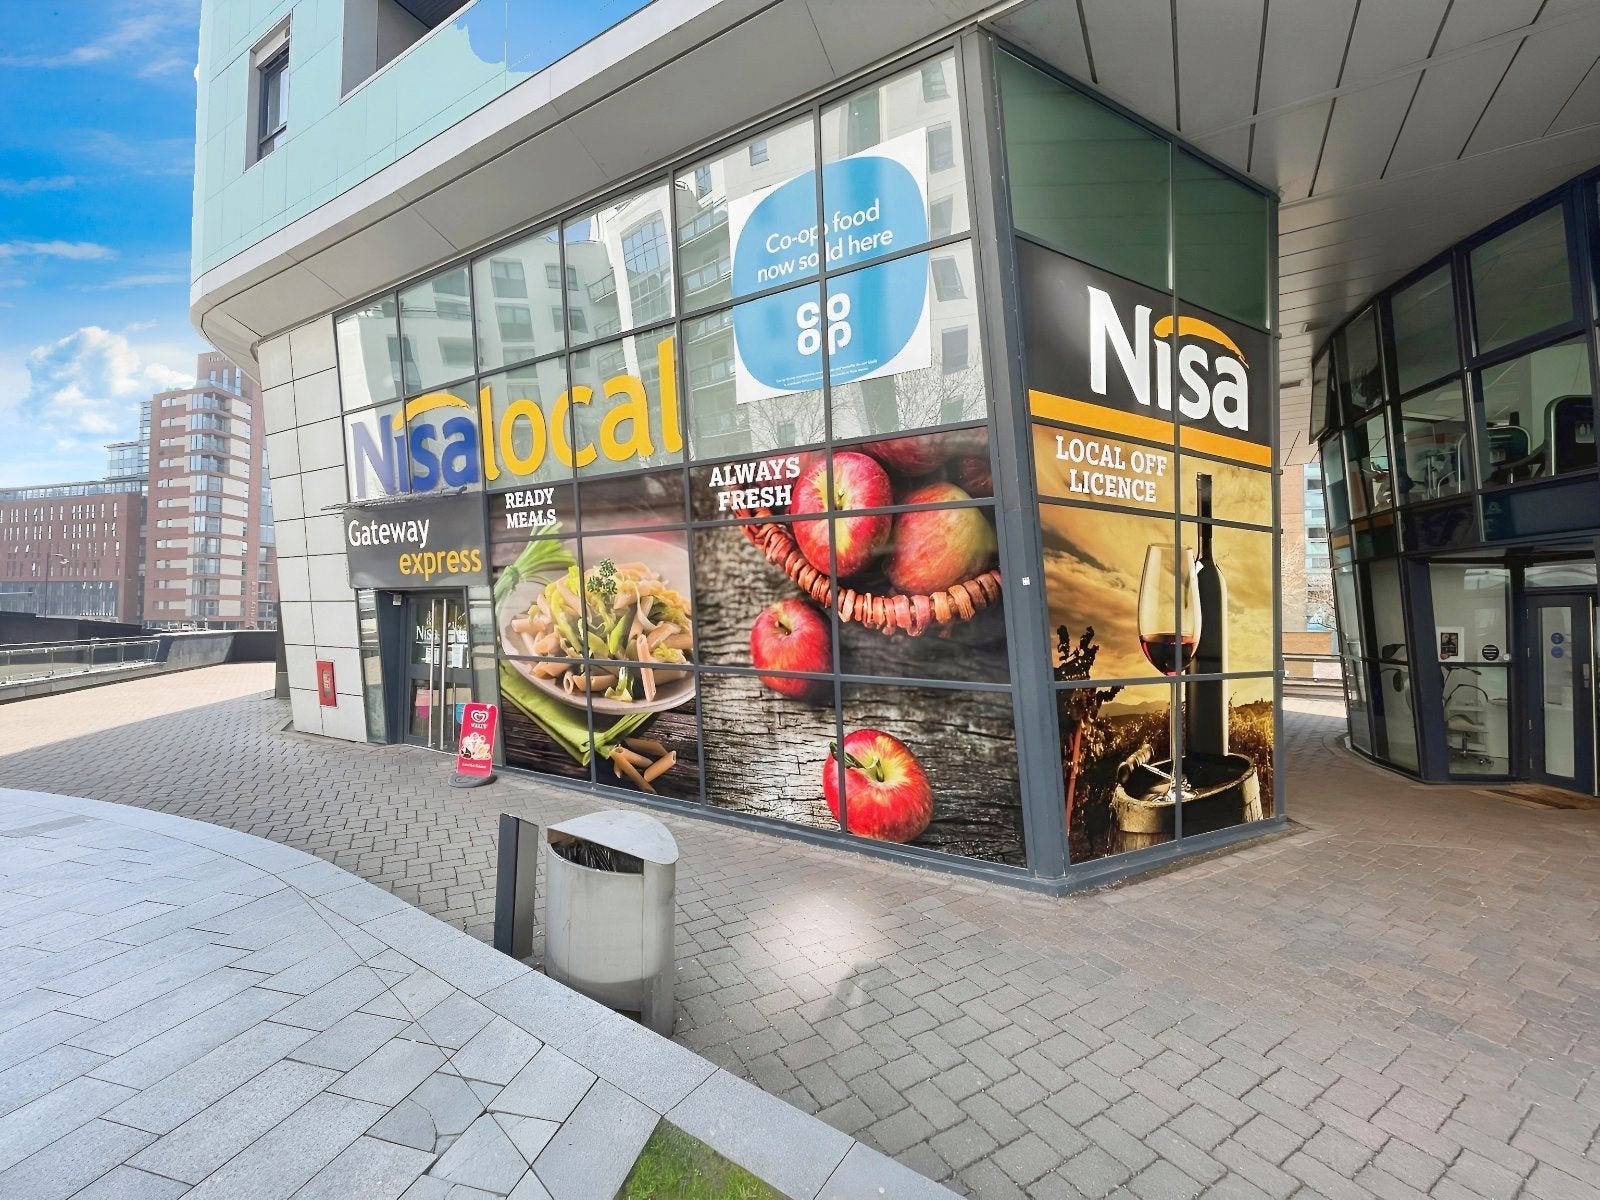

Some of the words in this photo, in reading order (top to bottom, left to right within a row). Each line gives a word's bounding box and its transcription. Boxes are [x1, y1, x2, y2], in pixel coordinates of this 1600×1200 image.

[766, 222, 829, 254] Co-op
[832, 197, 880, 233] food
[757, 259, 795, 283] now
[798, 237, 844, 271] sold
[848, 229, 894, 256] here
[1087, 285, 1249, 431] Nisa
[350, 393, 479, 500] Nisa
[479, 338, 683, 481] local
[708, 456, 801, 488] ALWAYS
[1055, 435, 1126, 470] LOCAL
[1130, 450, 1168, 477] OFF
[504, 487, 556, 509] READY
[718, 484, 793, 512] FRESH
[1069, 469, 1157, 503] LICENCE
[347, 518, 430, 549] Gateway
[505, 508, 557, 529] MEALS
[399, 548, 482, 582] express
